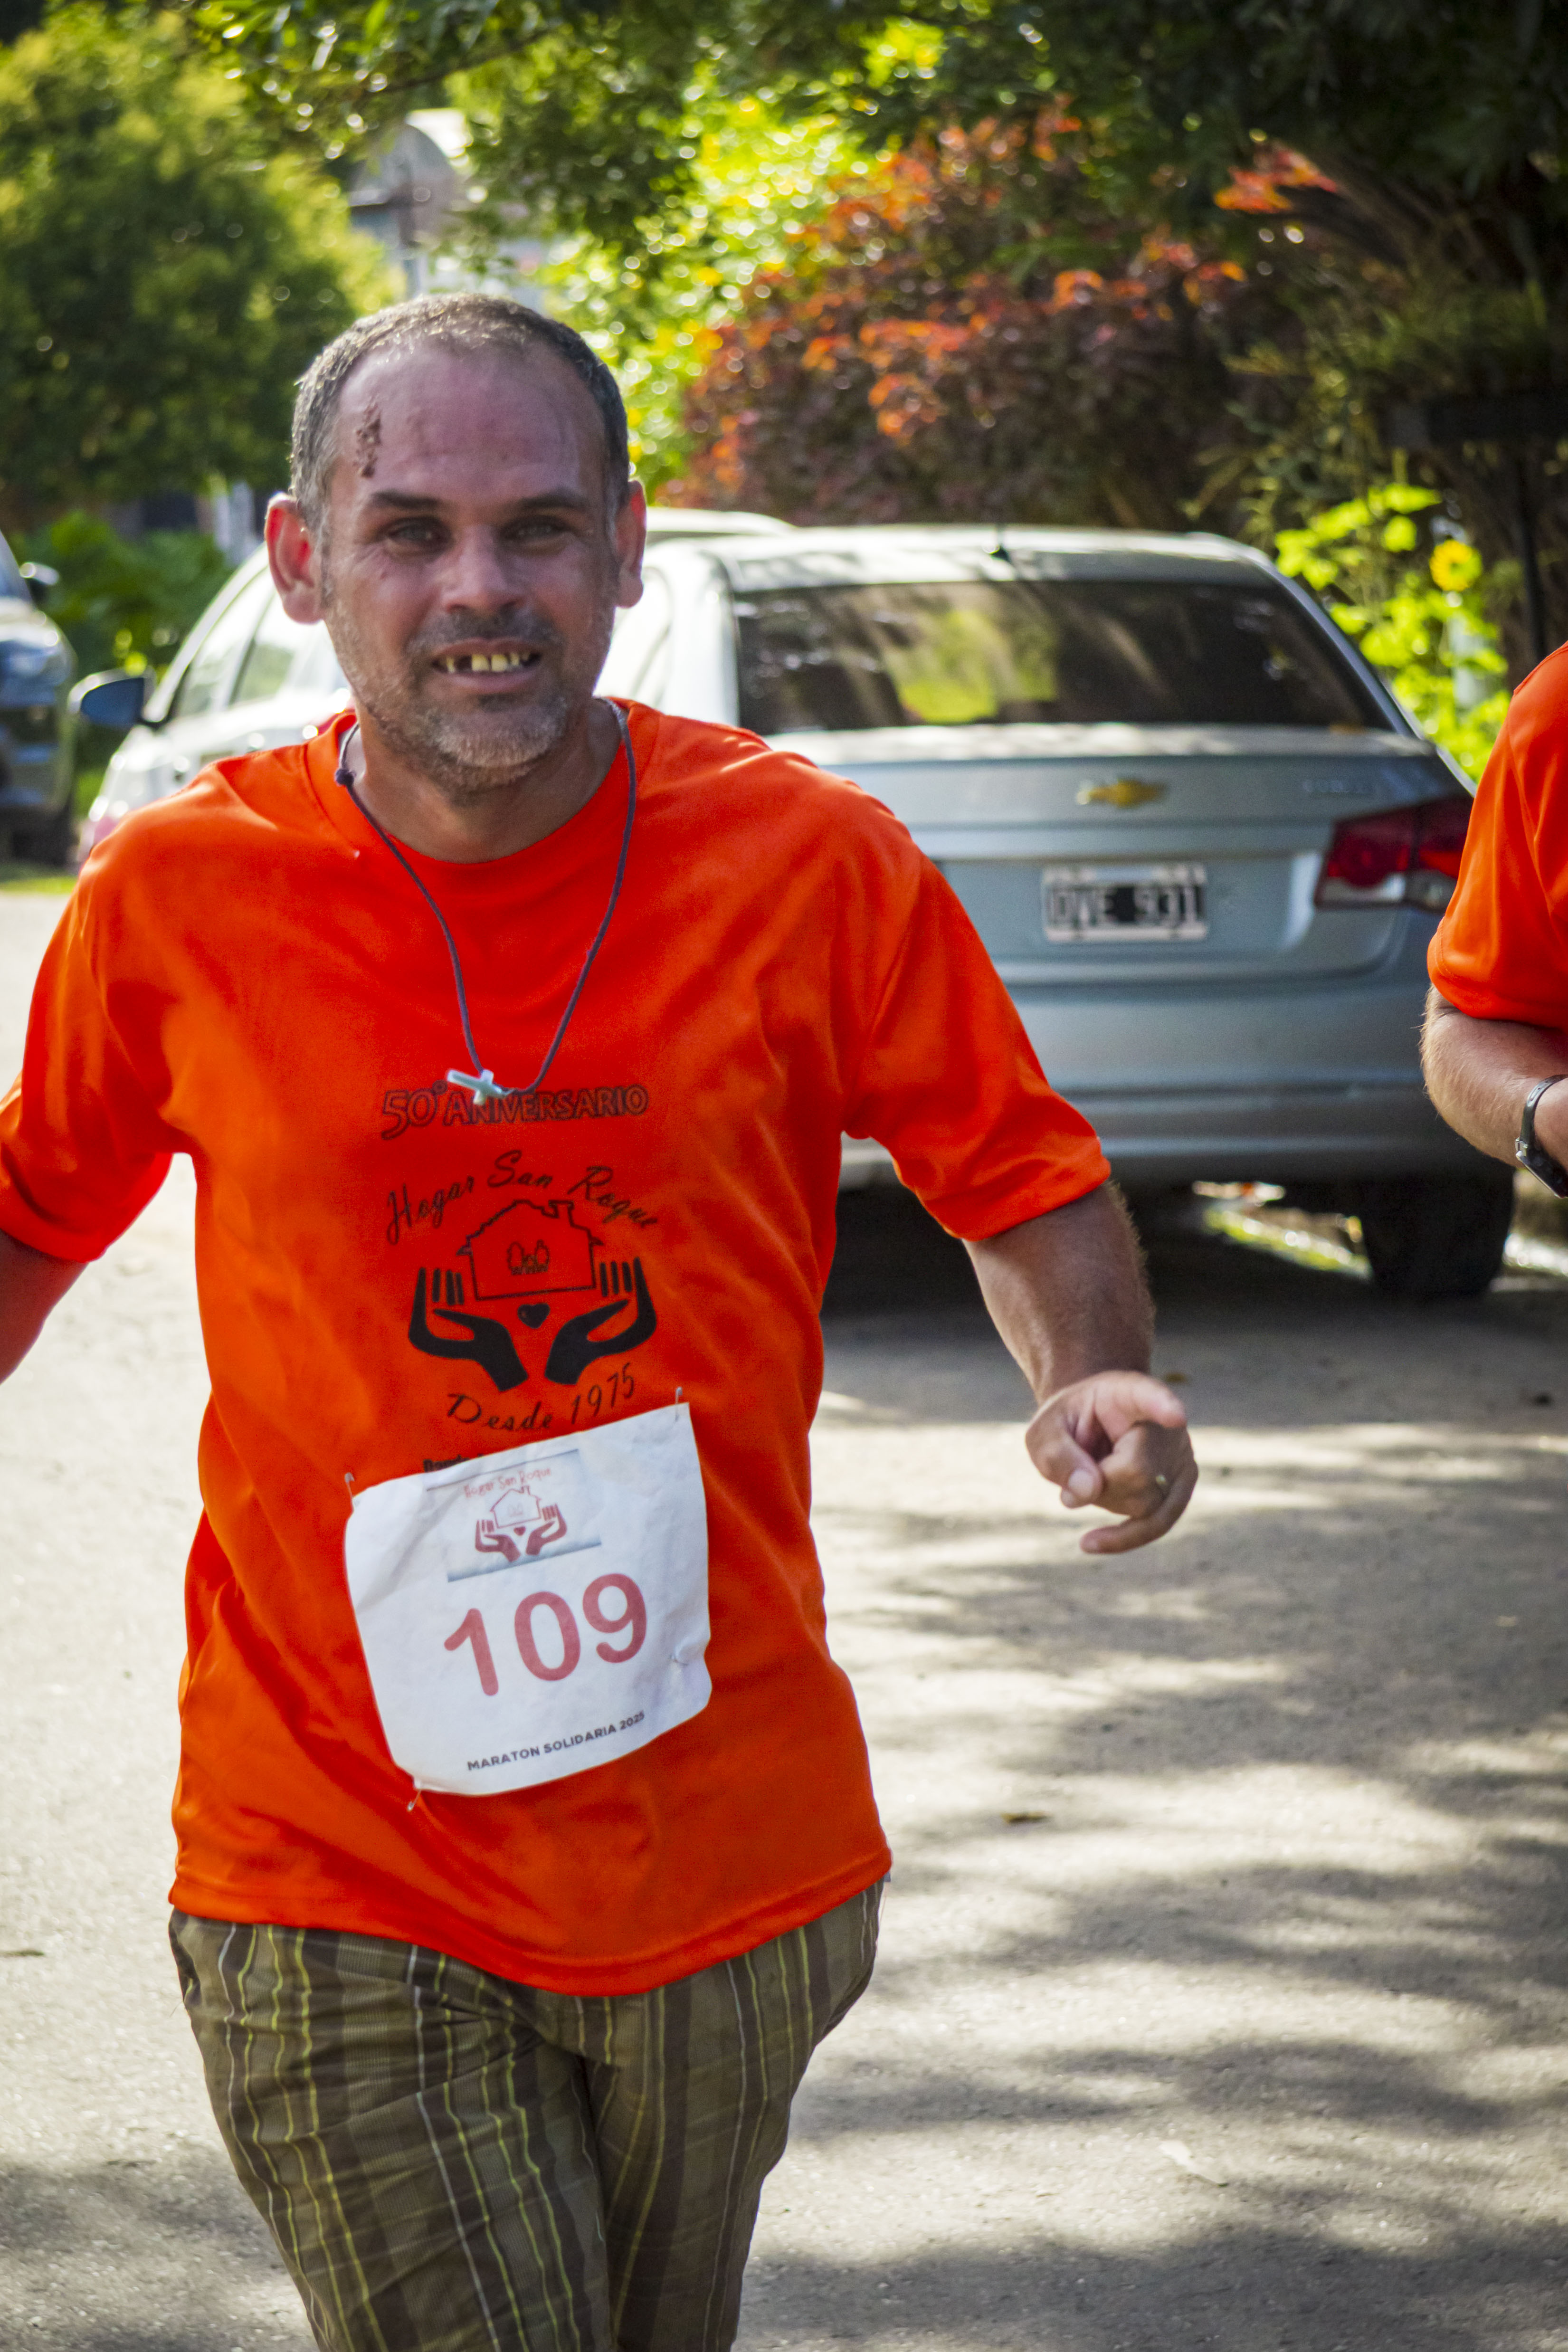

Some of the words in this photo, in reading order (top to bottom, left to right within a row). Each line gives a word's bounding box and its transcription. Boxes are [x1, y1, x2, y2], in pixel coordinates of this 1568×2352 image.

[442, 1084, 649, 1126] ANIVERSARIO
[387, 1176, 475, 1246] Hogar
[487, 1149, 553, 1188] San
[447, 1392, 552, 1431] Desde
[571, 1362, 635, 1425] 1975
[464, 1481, 494, 1498] Hogar
[498, 1475, 517, 1490] San
[518, 1468, 551, 1484] Roque
[444, 1573, 647, 1696] 109
[467, 1746, 540, 1771] MARATON
[543, 1724, 617, 1754] SOLIDARIA
[619, 1710, 645, 1730] 2025
